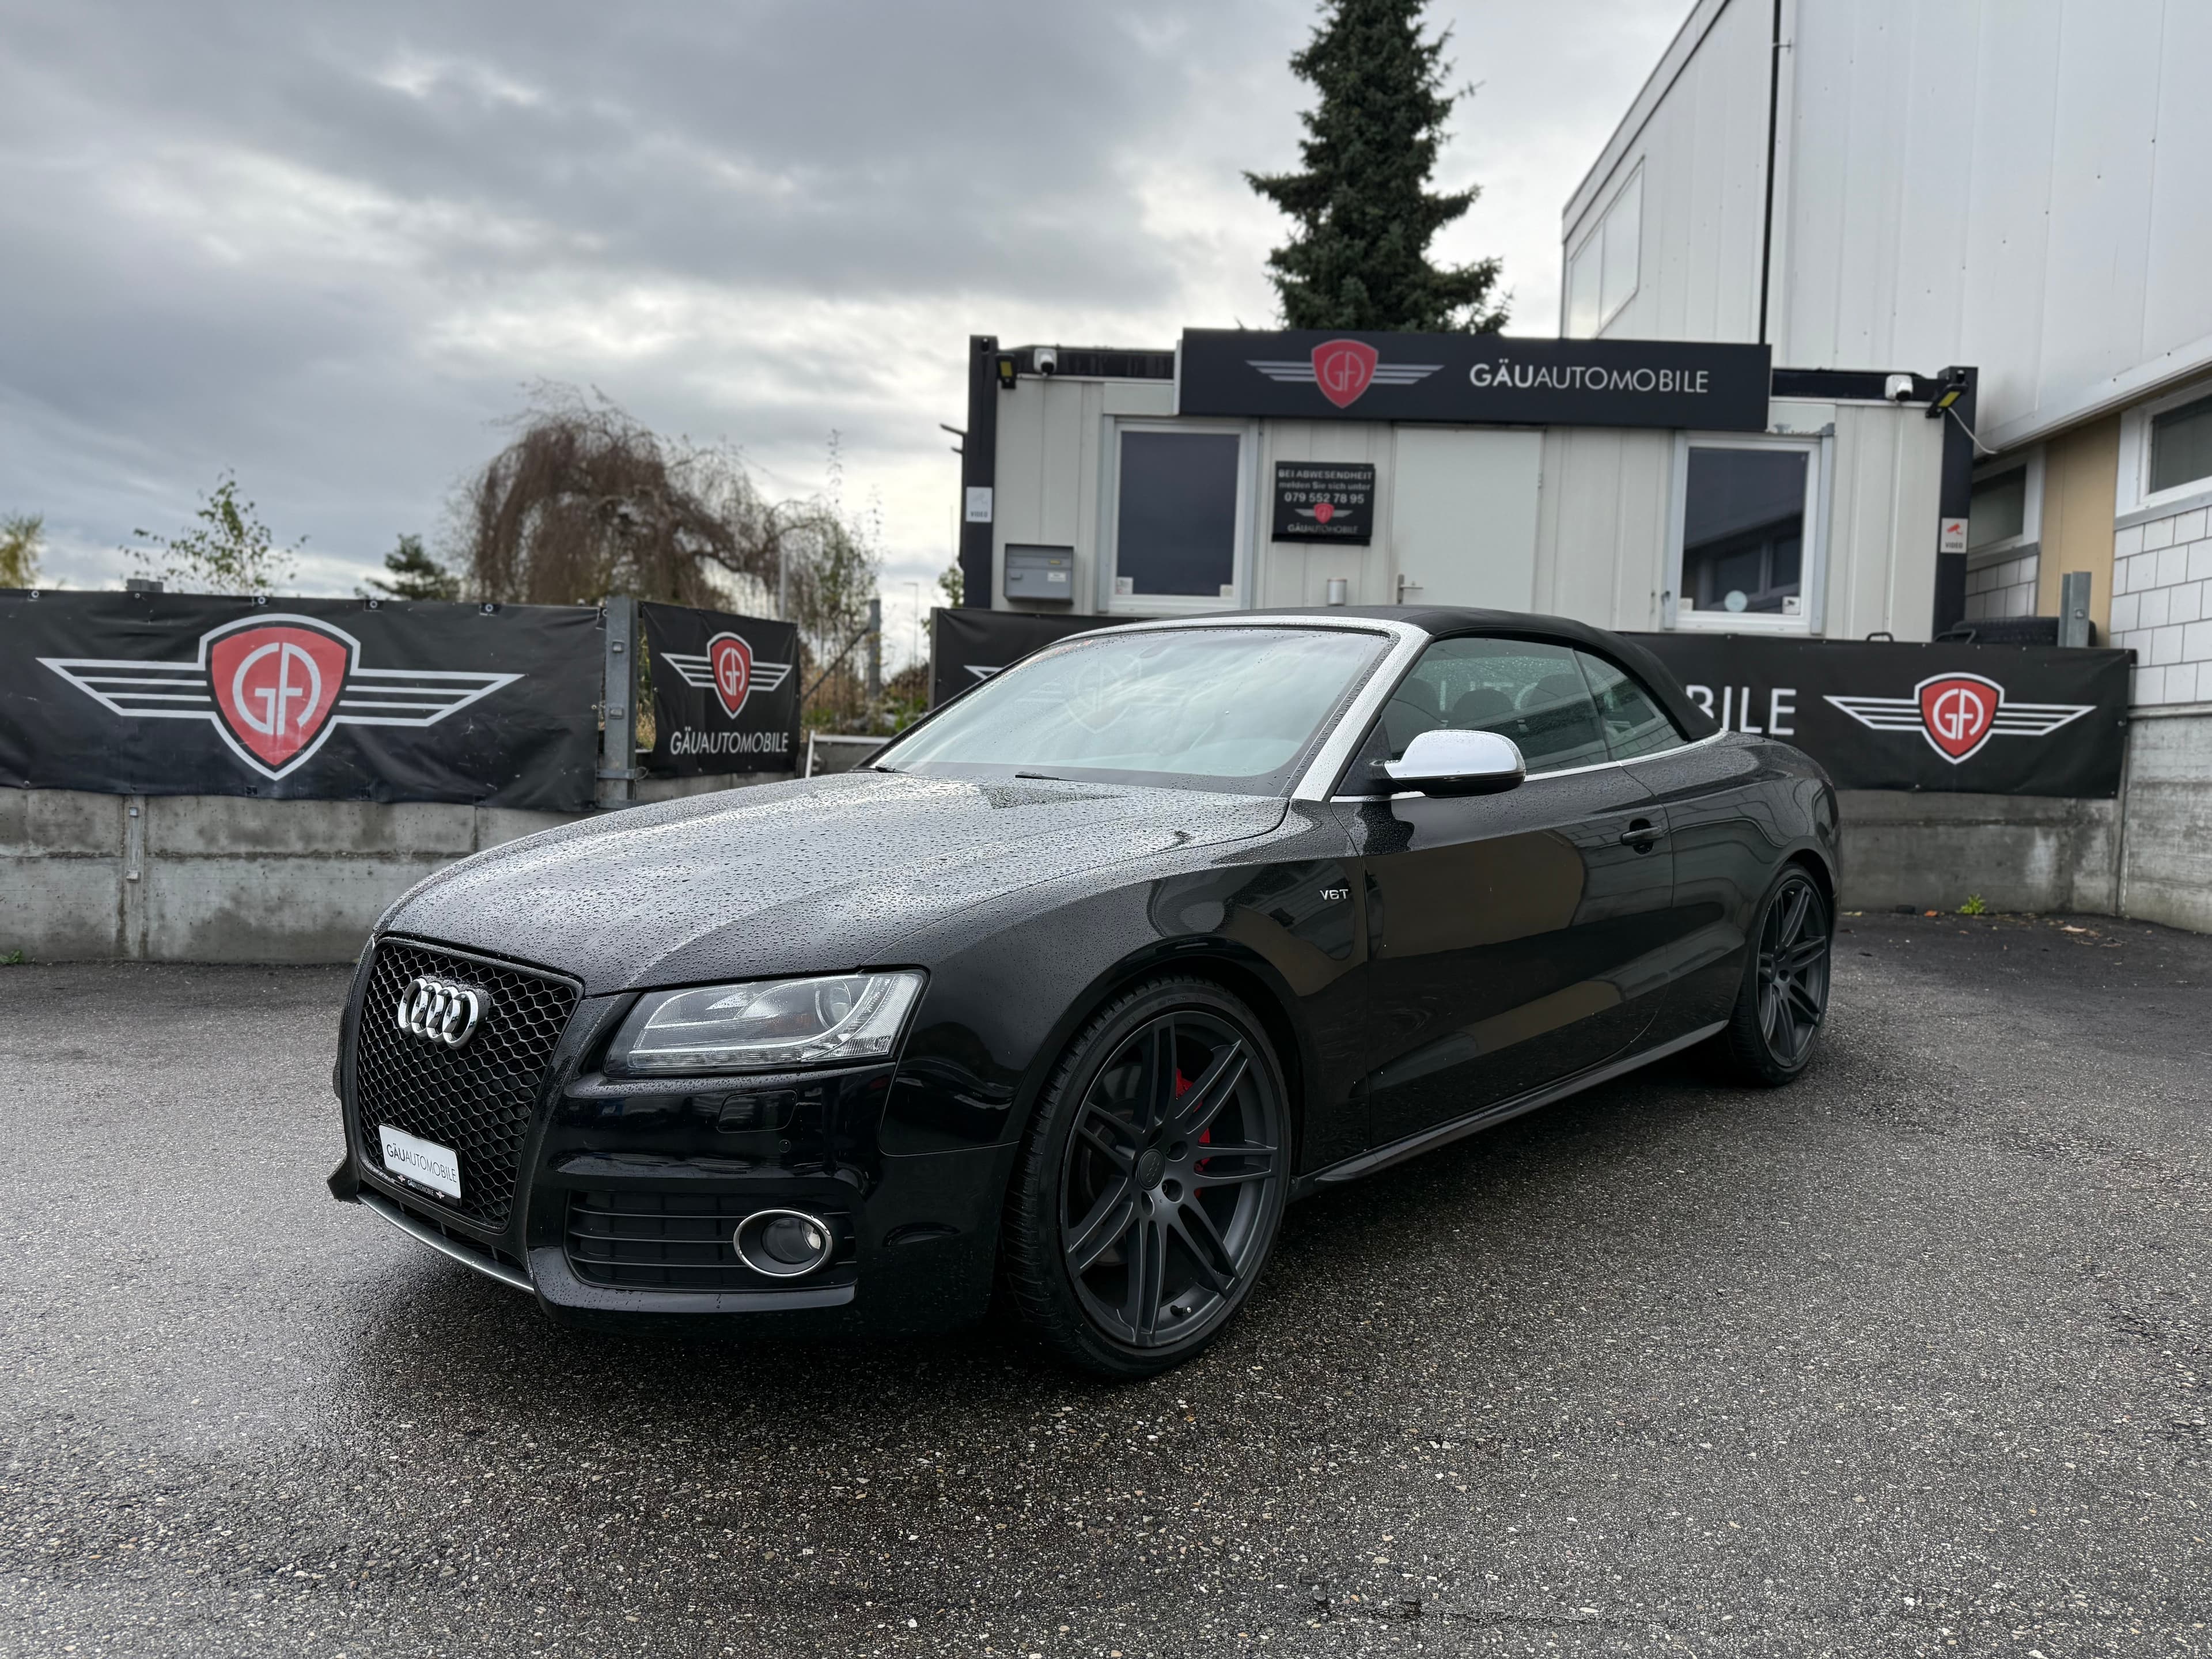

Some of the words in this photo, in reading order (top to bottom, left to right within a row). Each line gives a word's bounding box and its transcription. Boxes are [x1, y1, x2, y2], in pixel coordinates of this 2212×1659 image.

[1469, 358, 1709, 393] GÄUAUTOMOBILE
[1278, 469, 1294, 478] BEI
[1296, 470, 1372, 479] ABWESENDHEIT
[1278, 481, 1310, 489] melden
[1327, 482, 1346, 490] sich
[1284, 492, 1306, 502] 079
[1309, 493, 1330, 503] 552
[1333, 493, 1347, 503] 78
[1350, 494, 1365, 504] 95
[670, 726, 789, 755] GÄUAUTOMOBILE
[1319, 889, 1349, 900] V6T
[387, 1143, 457, 1183] GÄUAUTOMOBILE
